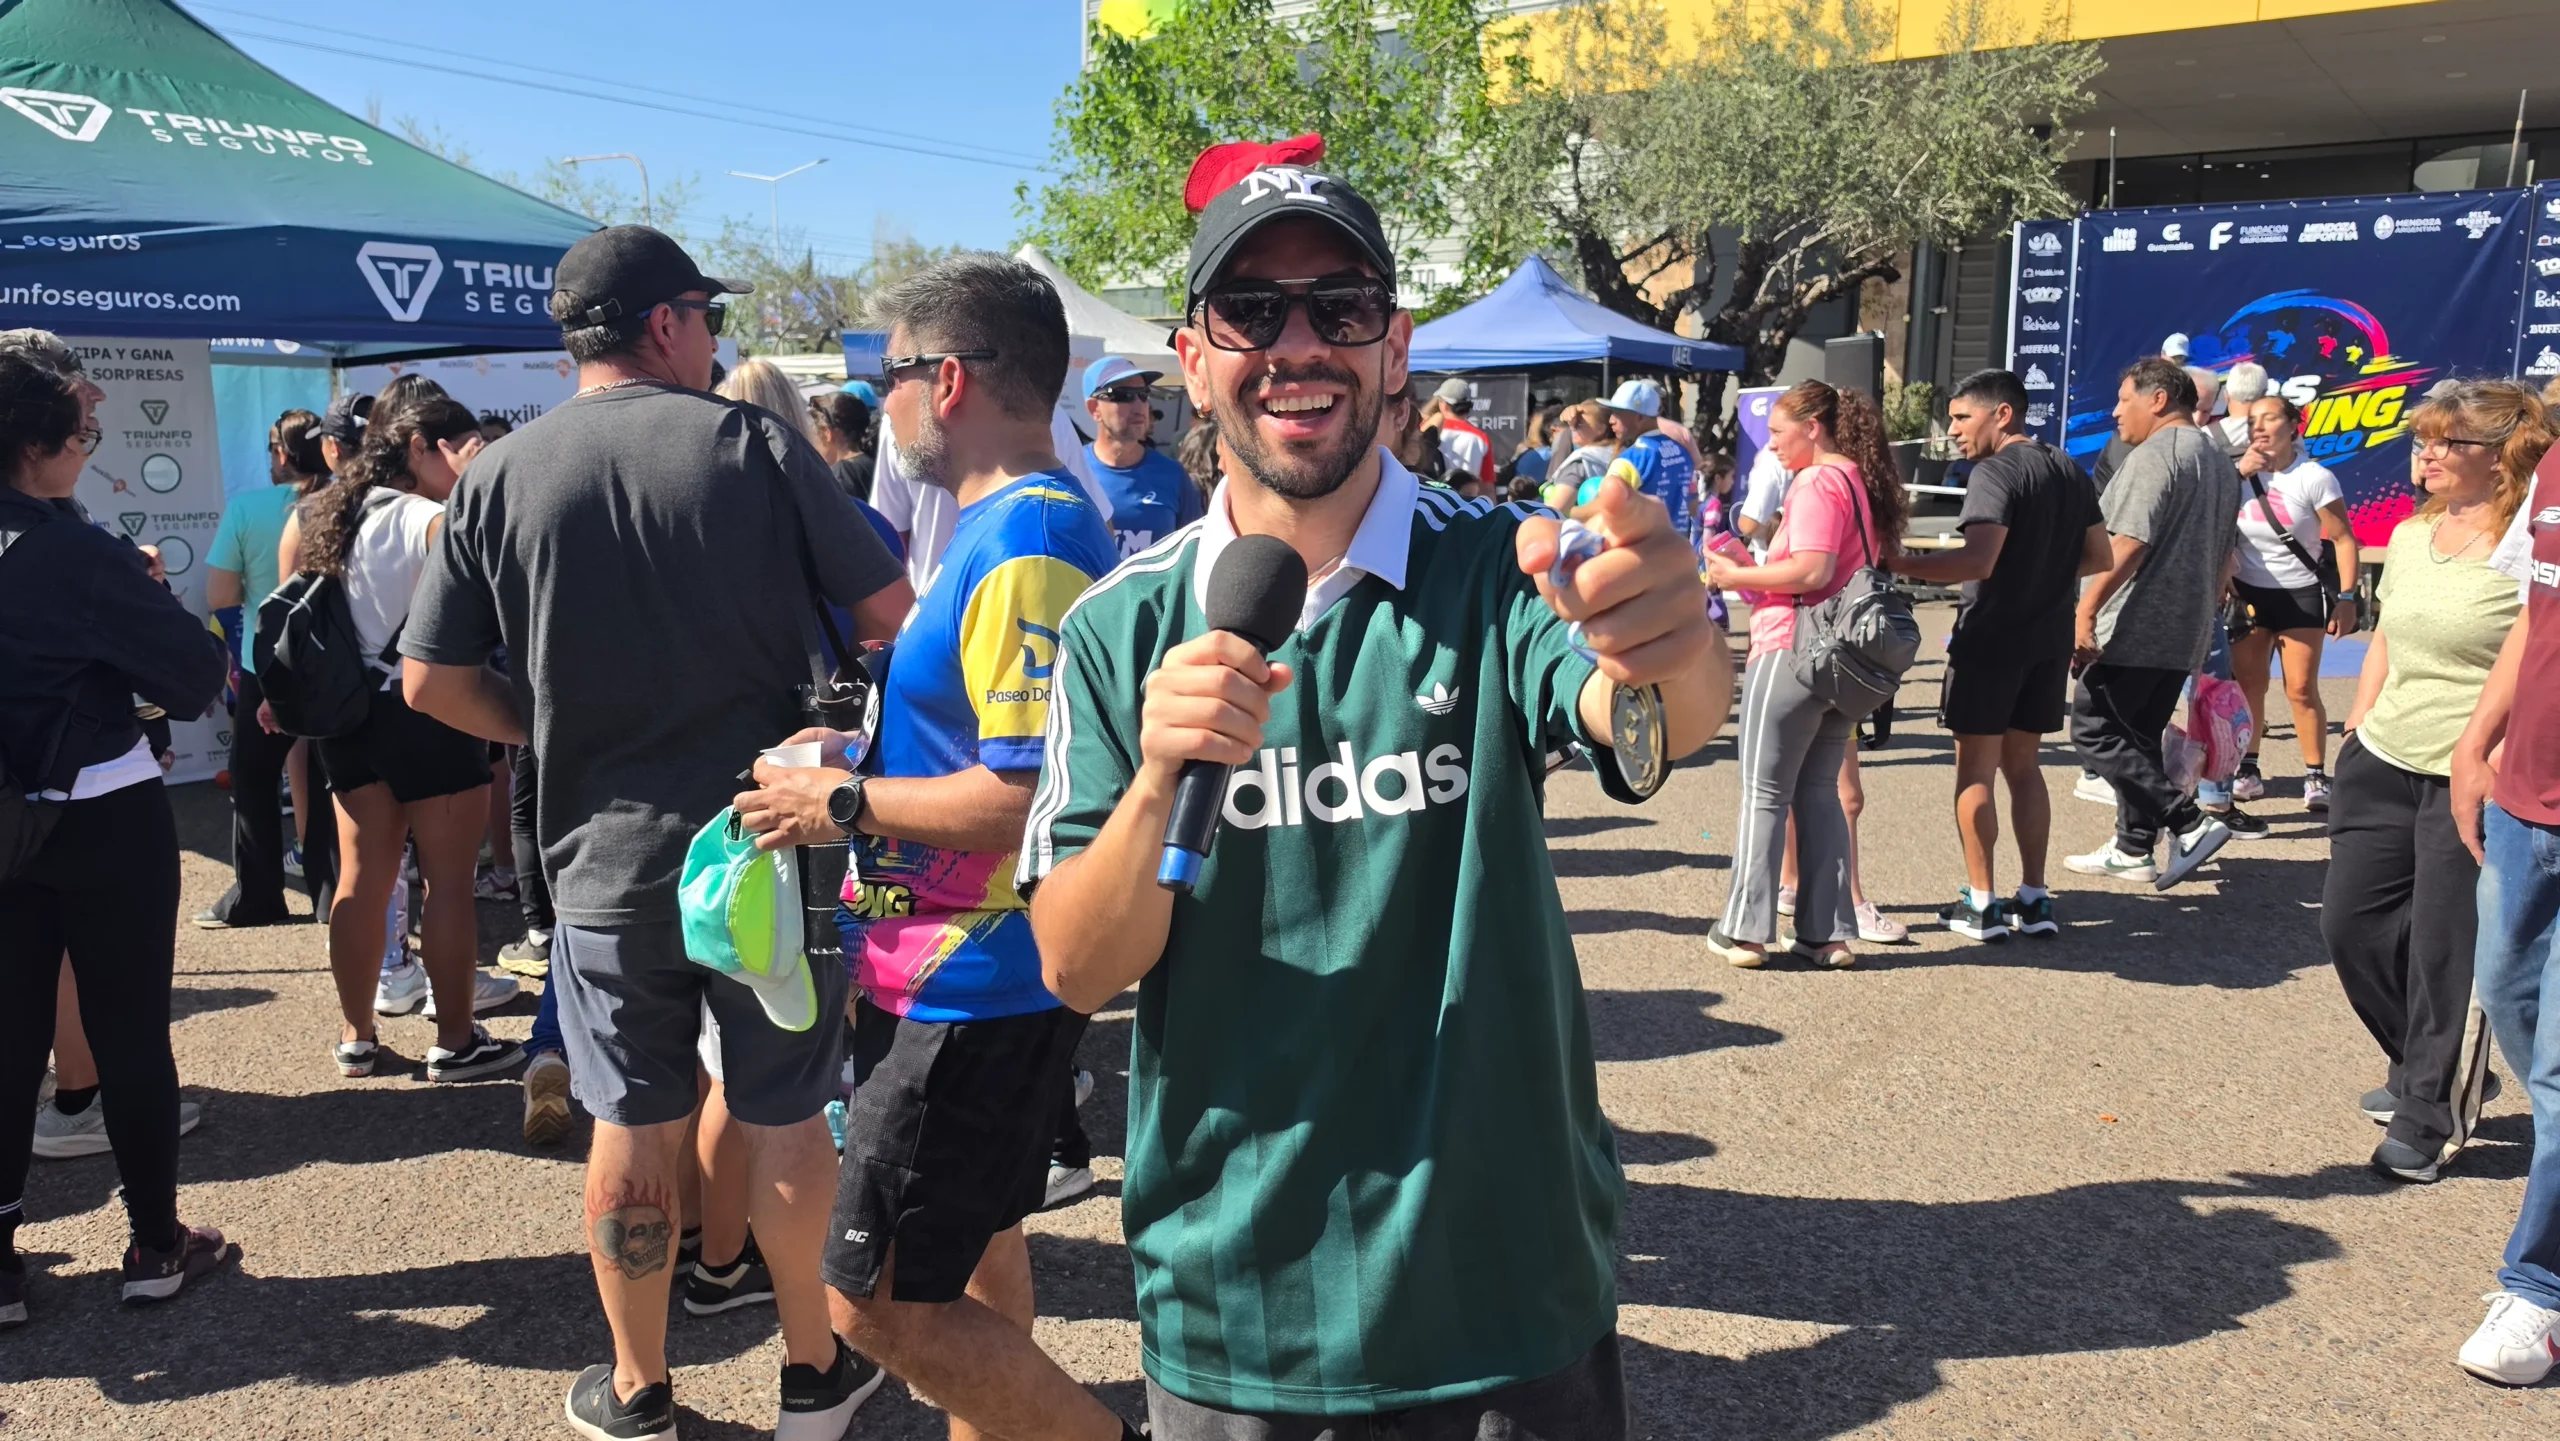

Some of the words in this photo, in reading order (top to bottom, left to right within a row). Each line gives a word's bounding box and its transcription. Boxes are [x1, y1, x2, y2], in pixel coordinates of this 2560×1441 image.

[126, 107, 368, 153] TRIUNFO
[151, 128, 374, 166] SEGUROS
[1239, 167, 1329, 205] NY
[2303, 222, 2356, 233] MENDOZA
[2395, 218, 2441, 227] MENDOZA
[2113, 227, 2137, 240] free
[2298, 232, 2359, 243] DEPORTIVA
[0, 235, 141, 251] _seguros
[115, 348, 127, 360] Y
[131, 349, 174, 361] GANA
[92, 368, 184, 381] SORPRESAS
[480, 404, 541, 424] auxili
[1482, 416, 1517, 430] RIFT
[122, 430, 193, 440] TRIUNFO
[126, 440, 192, 449] SEGUROS
[151, 512, 220, 522] TRIUNFO
[986, 689, 1030, 704] Paseo
[1215, 741, 1469, 832] didas
